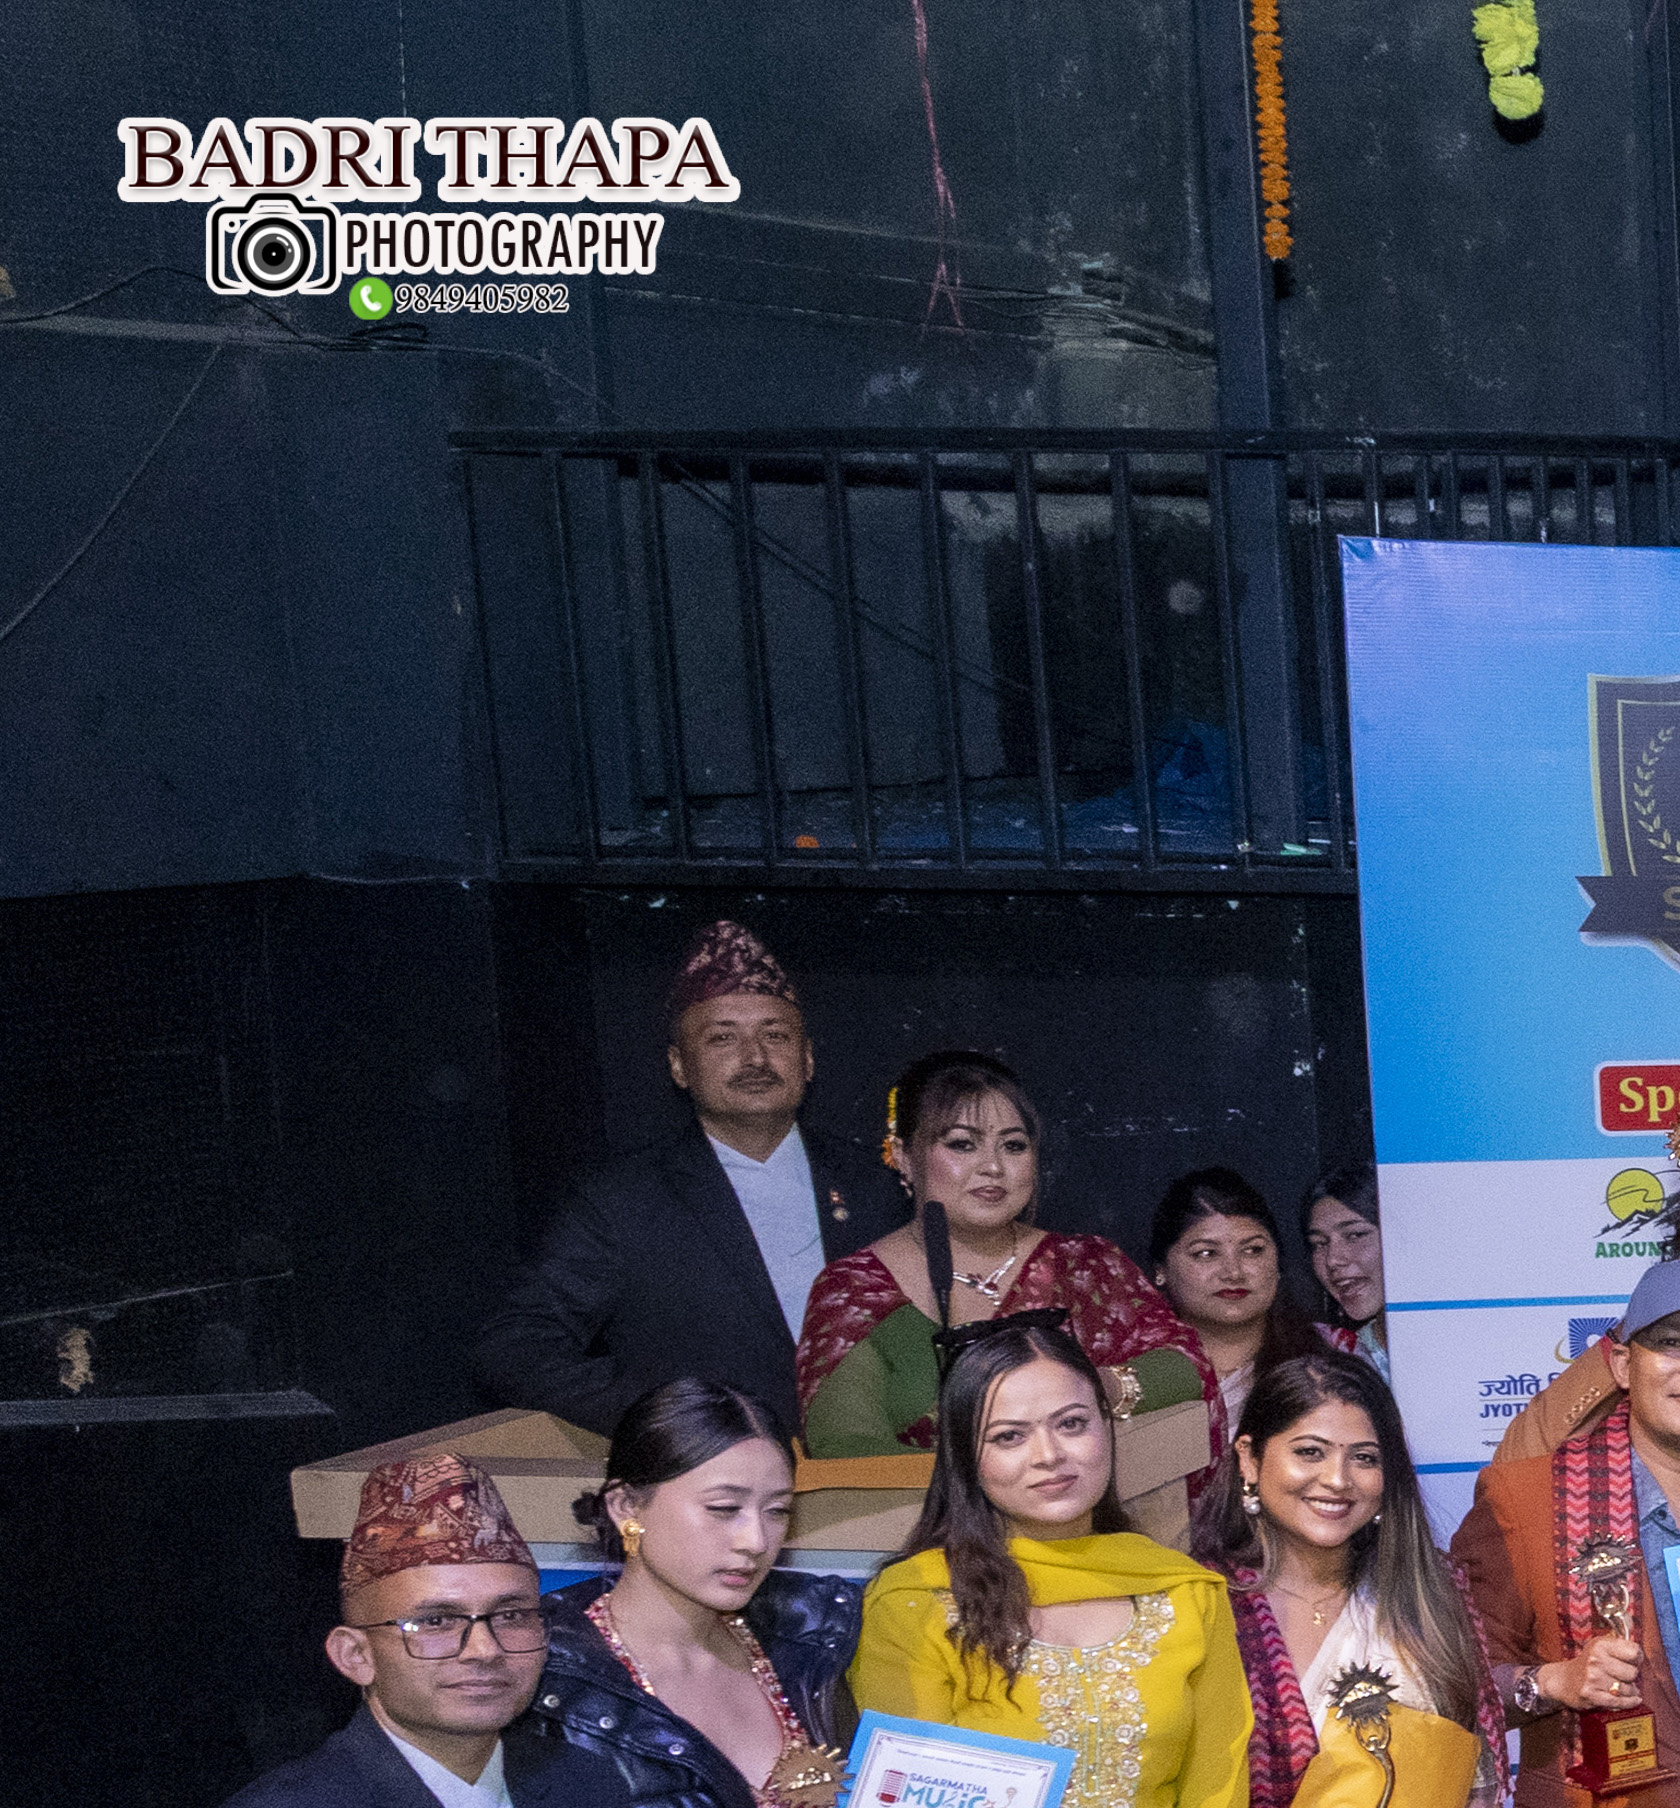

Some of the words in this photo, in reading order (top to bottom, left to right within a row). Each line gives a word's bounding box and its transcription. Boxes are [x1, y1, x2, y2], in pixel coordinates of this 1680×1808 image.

[1595, 1241, 1670, 1258] AROUN
[1478, 1373, 1541, 1397] ज्योति
[909, 1772, 988, 1795] SAGARMATHA
